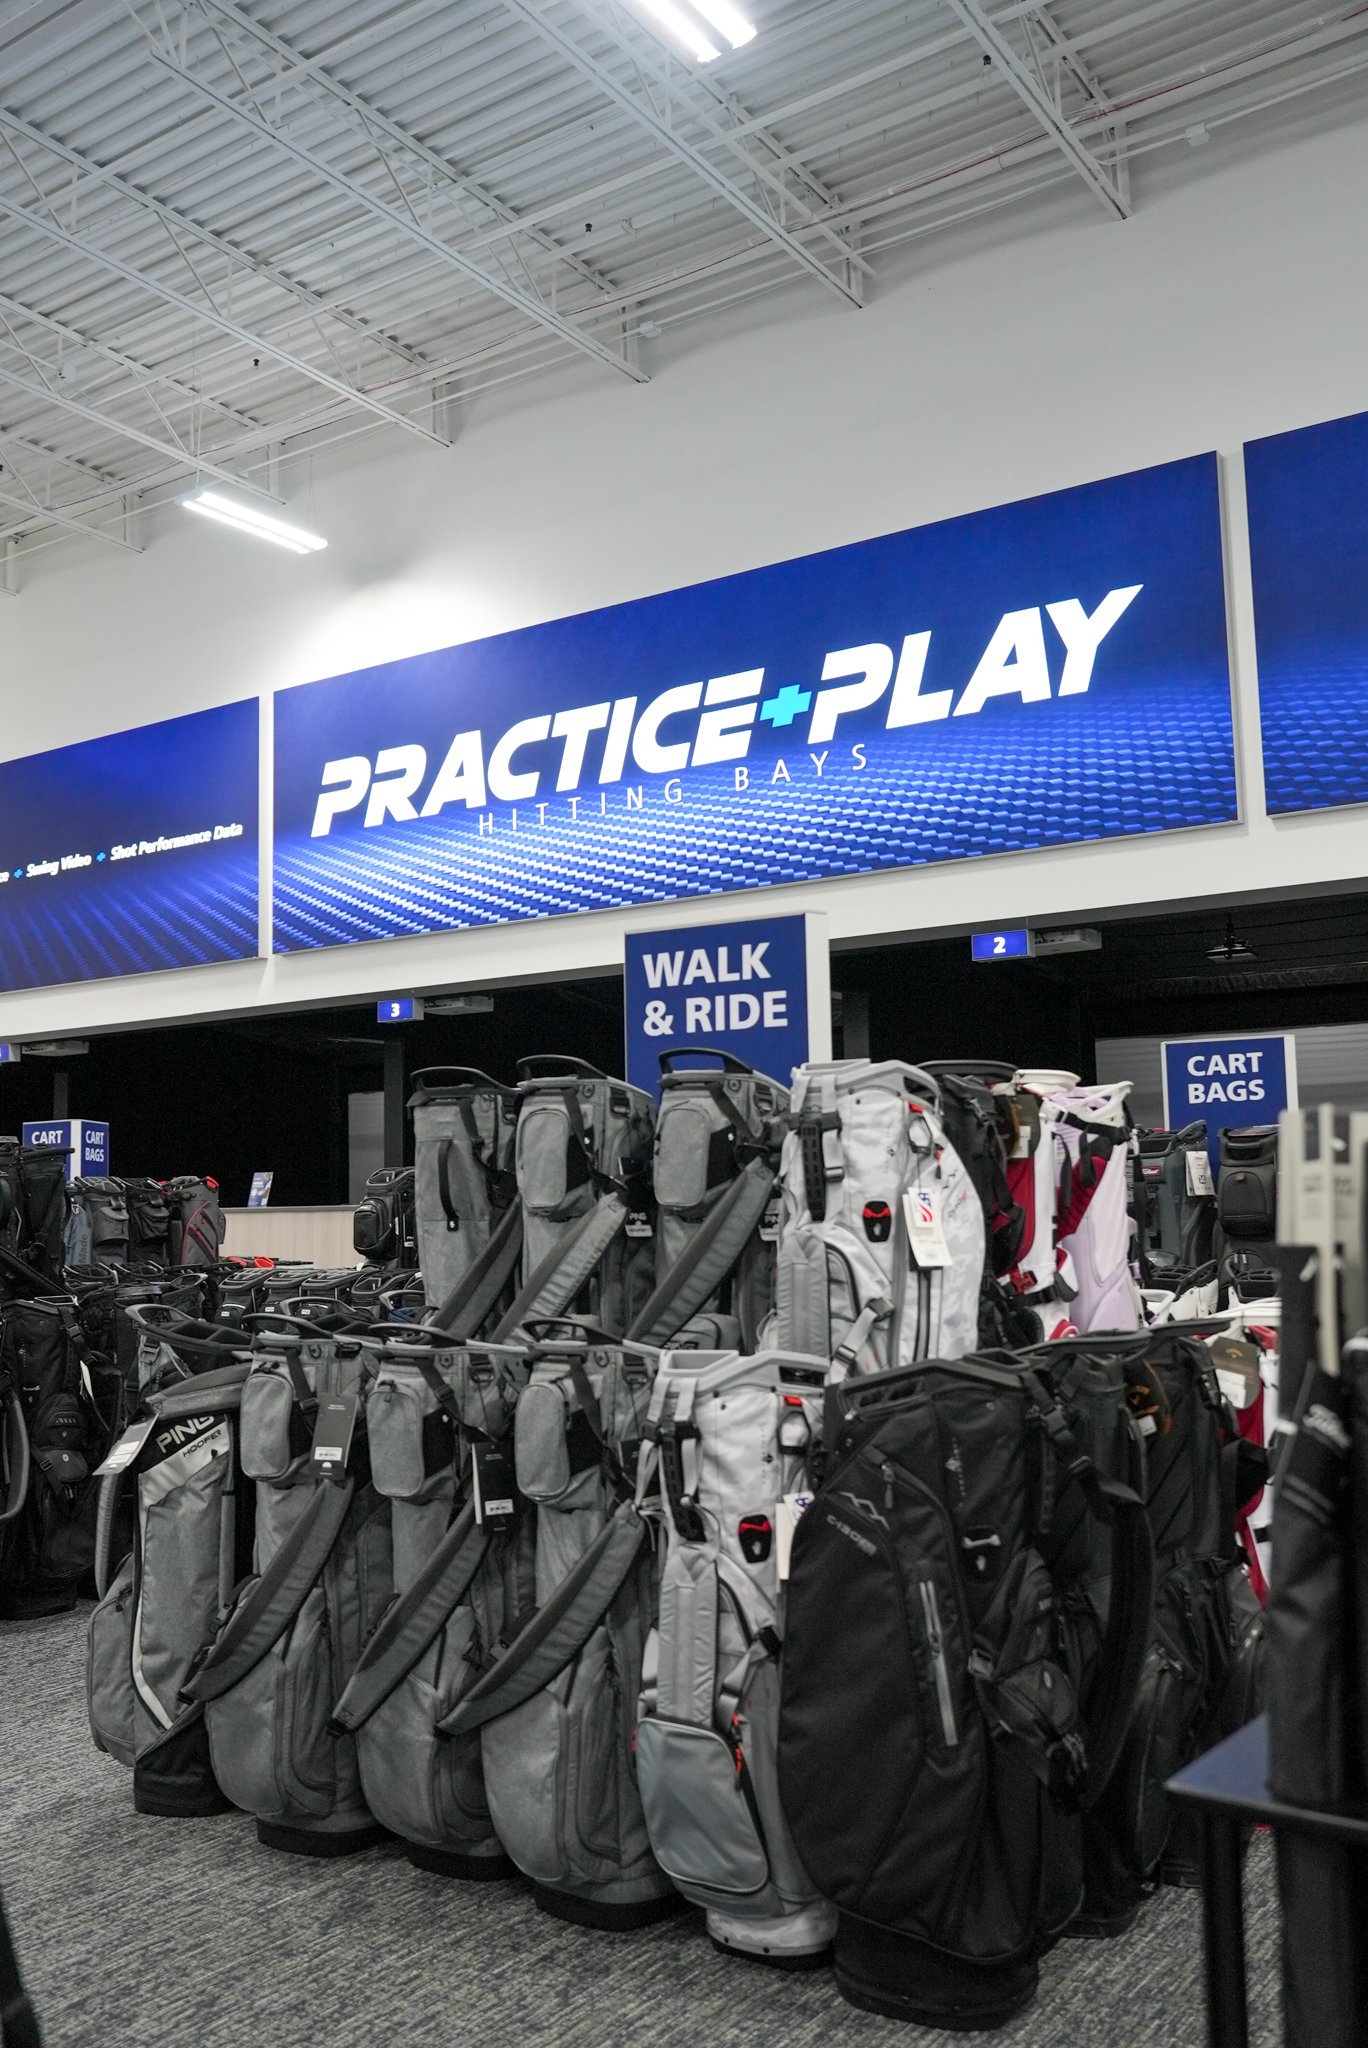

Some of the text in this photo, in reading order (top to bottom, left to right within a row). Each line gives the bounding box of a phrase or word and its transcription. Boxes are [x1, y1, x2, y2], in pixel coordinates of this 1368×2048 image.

[479, 743, 867, 836] HITTING BAYS
[26, 860, 59, 876] Swing
[61, 853, 92, 870] Video
[110, 845, 137, 861] Shot
[138, 829, 212, 855] Performance
[213, 823, 243, 841] Data
[993, 936, 1006, 954] 2
[642, 942, 772, 988] WALK
[390, 1003, 400, 1018] 3
[643, 990, 788, 1036] & RIDE
[1187, 1052, 1263, 1077] CART
[1188, 1079, 1266, 1104] BAGS
[31, 1130, 63, 1145] CART
[85, 1130, 105, 1145] CART
[85, 1147, 105, 1162] BAGS
[156, 1415, 215, 1454] PING
[183, 1429, 222, 1457] HOOFER
